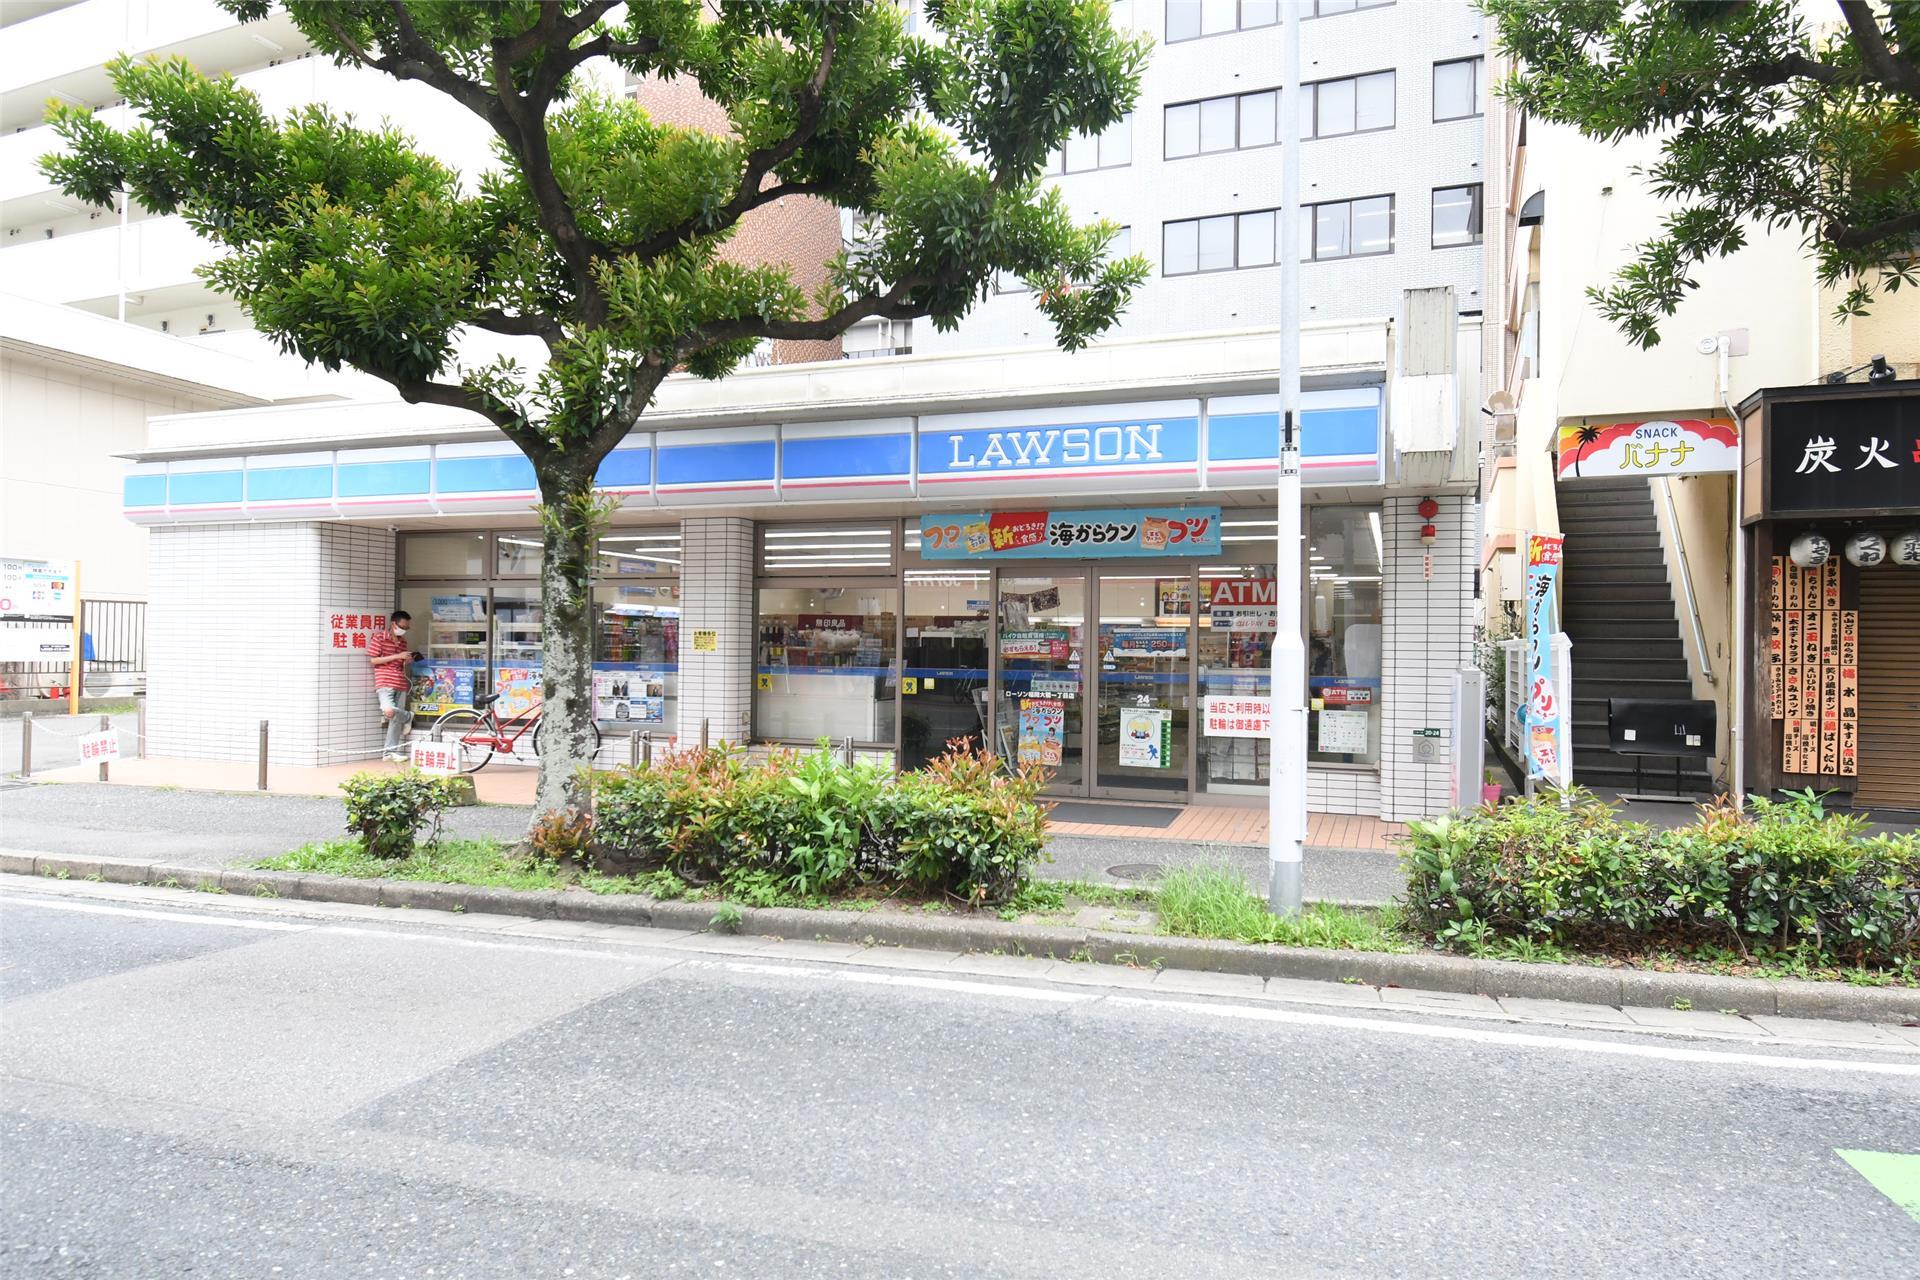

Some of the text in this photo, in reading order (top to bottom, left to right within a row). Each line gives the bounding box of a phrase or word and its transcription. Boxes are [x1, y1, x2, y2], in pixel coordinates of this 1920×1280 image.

[1635, 427, 1678, 440] SNACK
[949, 424, 1163, 468] LAWSON
[1620, 440, 1694, 470] バナナ
[991, 525, 1014, 549] 新
[1050, 522, 1137, 546] 海からクン
[1213, 581, 1277, 603] ATM
[330, 613, 386, 630] 従業員用
[332, 632, 375, 649] 駐輪
[1136, 694, 1150, 704] 24
[1788, 667, 1799, 717] ささみユッケ
[82, 738, 118, 760] 駐輪禁止
[414, 749, 457, 770] 駐輪禁止
